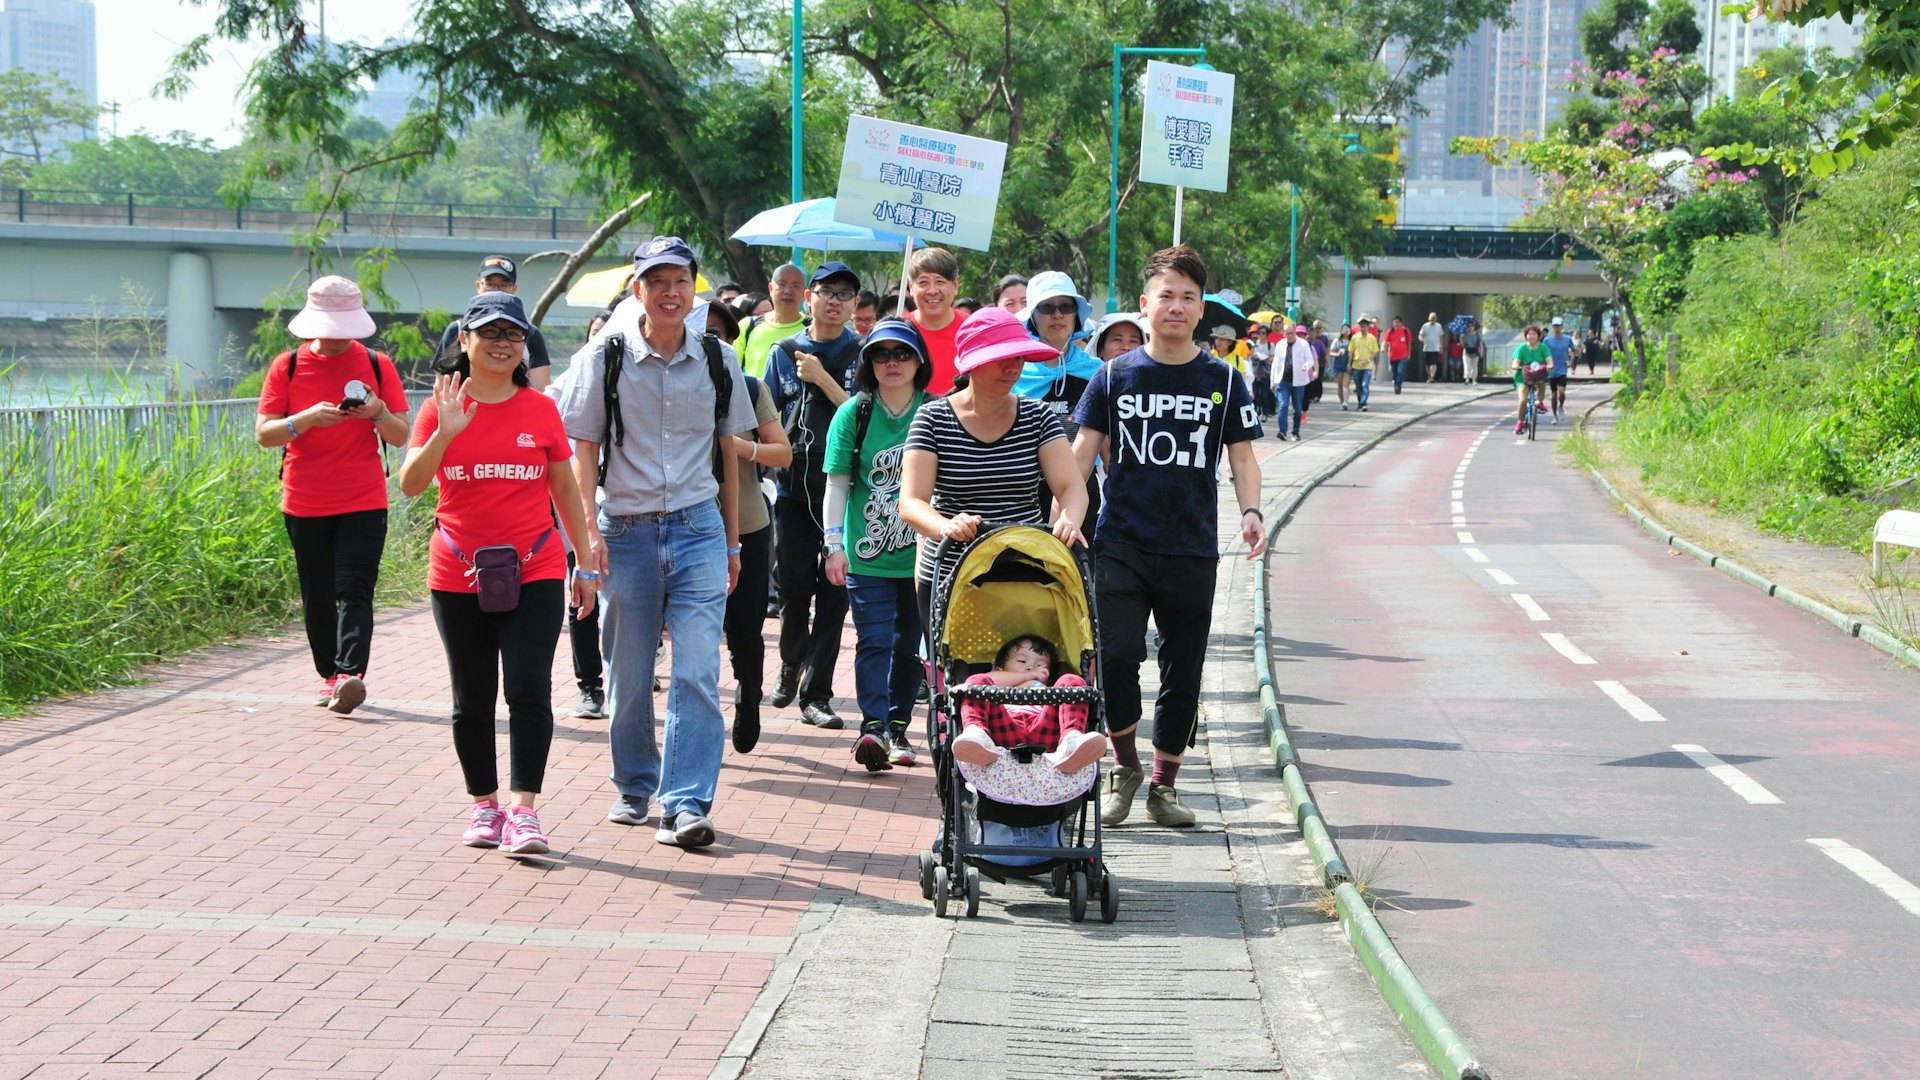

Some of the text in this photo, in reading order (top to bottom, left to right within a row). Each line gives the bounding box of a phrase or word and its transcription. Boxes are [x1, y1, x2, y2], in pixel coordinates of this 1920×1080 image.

[1165, 115, 1212, 145] 博愛醫院
[1168, 144, 1204, 170] 手術室
[880, 162, 962, 196] 青山醫院
[911, 192, 923, 205] 及
[873, 200, 956, 234] 小欖醫院
[1117, 393, 1214, 424] SUPER
[1117, 420, 1210, 469] No.1
[443, 465, 470, 481] WE,
